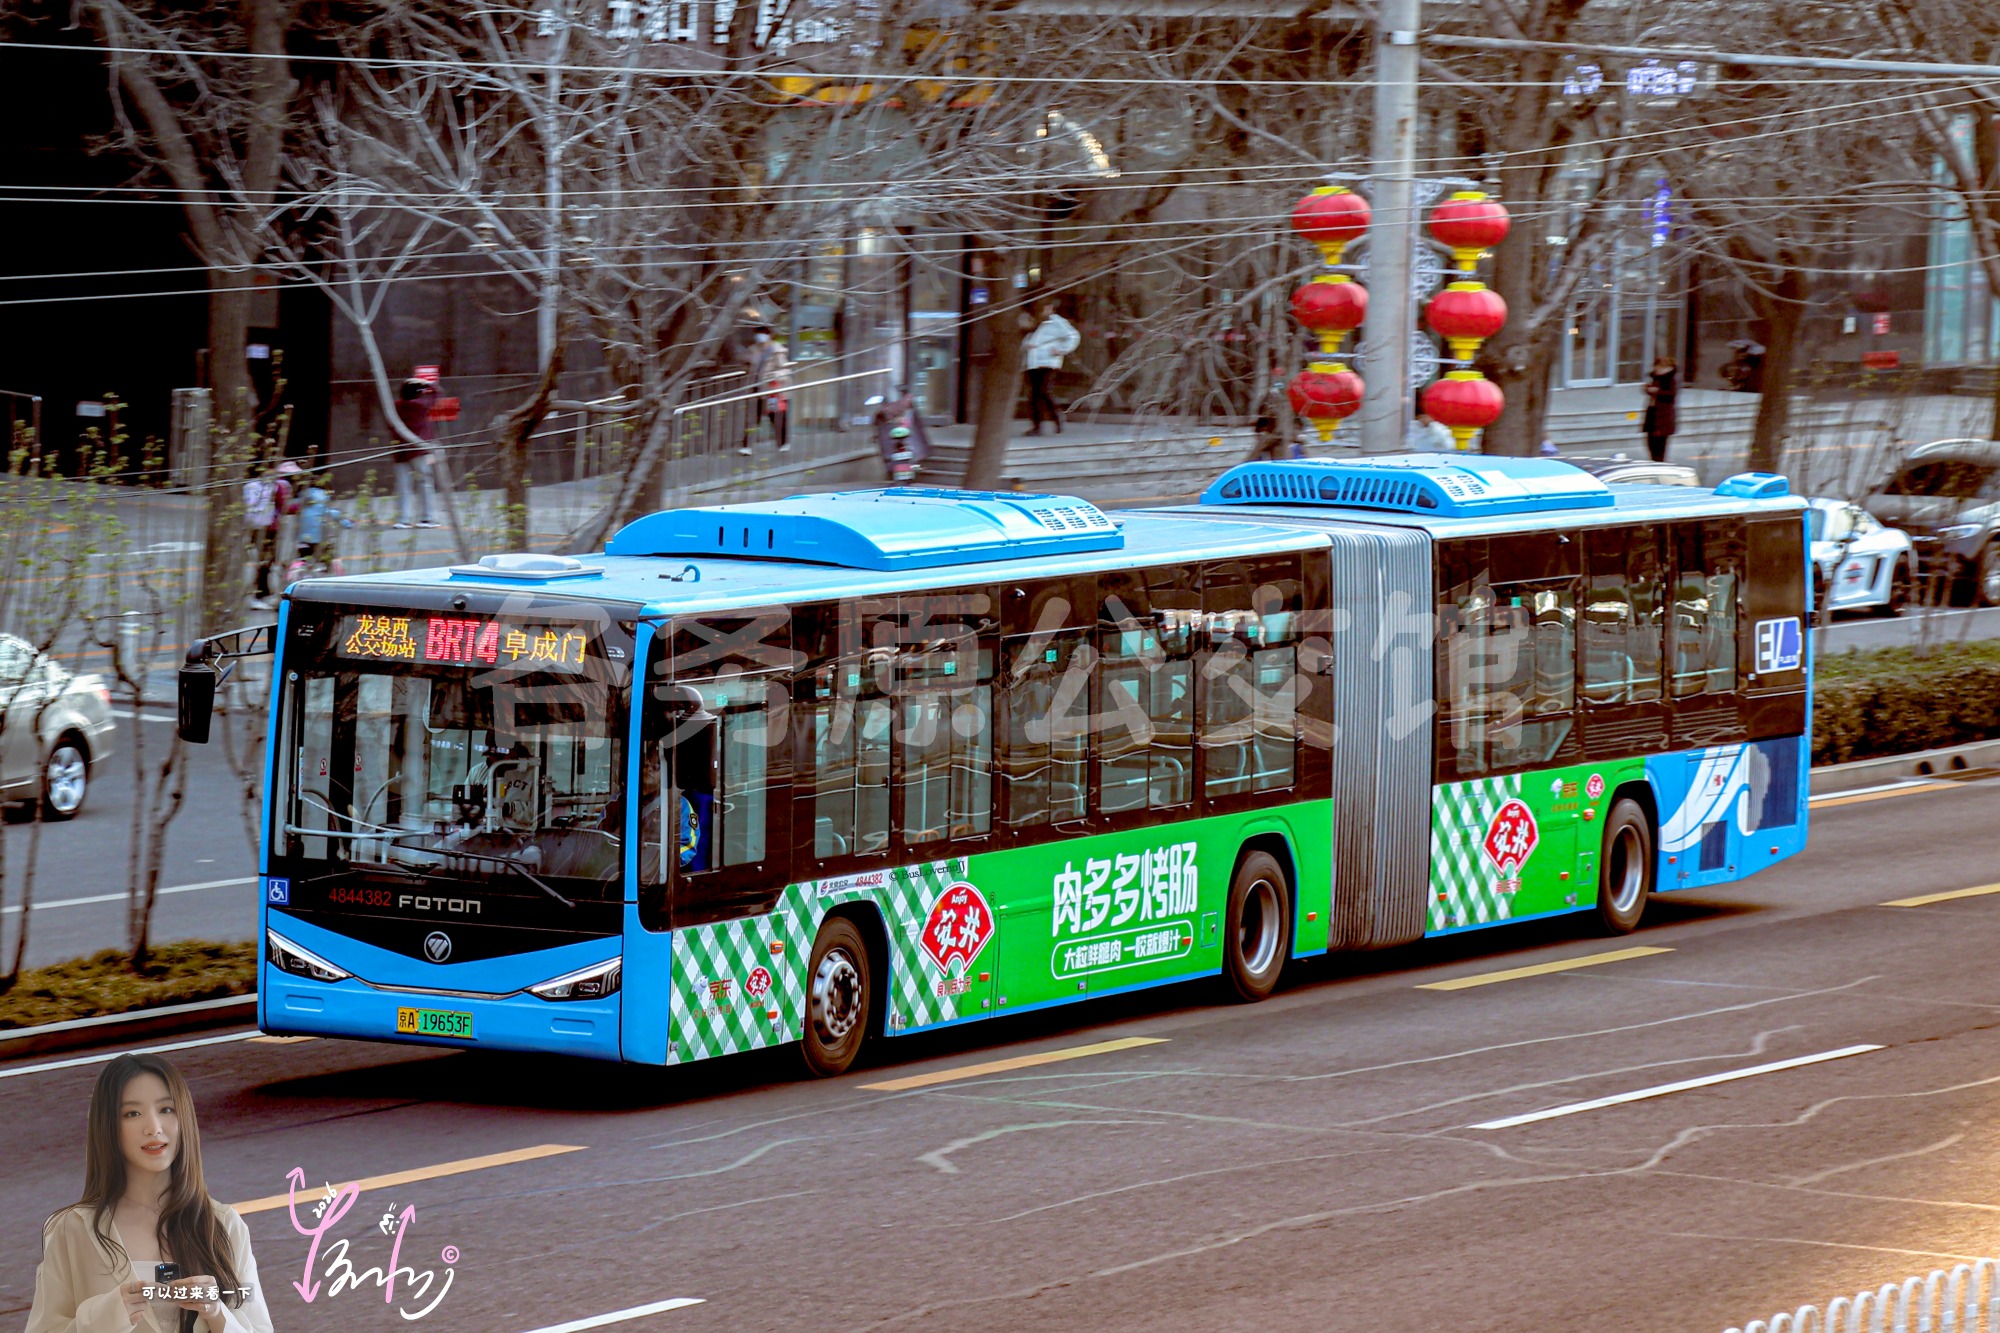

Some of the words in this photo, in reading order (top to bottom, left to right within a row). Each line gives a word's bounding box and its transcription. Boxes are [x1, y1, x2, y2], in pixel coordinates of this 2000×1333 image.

[356, 614, 411, 640] 龙泉西
[345, 633, 417, 659] 公交场站
[424, 618, 500, 664] BRT4
[501, 629, 587, 664] 阜成门
[1493, 818, 1529, 862] 安井
[855, 872, 883, 888] 4844382
[1052, 841, 1198, 937] 肉多多烤肠
[328, 888, 392, 907] 4844382
[398, 895, 481, 914] FOTON
[951, 891, 968, 906] Anjoy
[934, 905, 981, 958] 安井
[709, 978, 733, 1000] 京东
